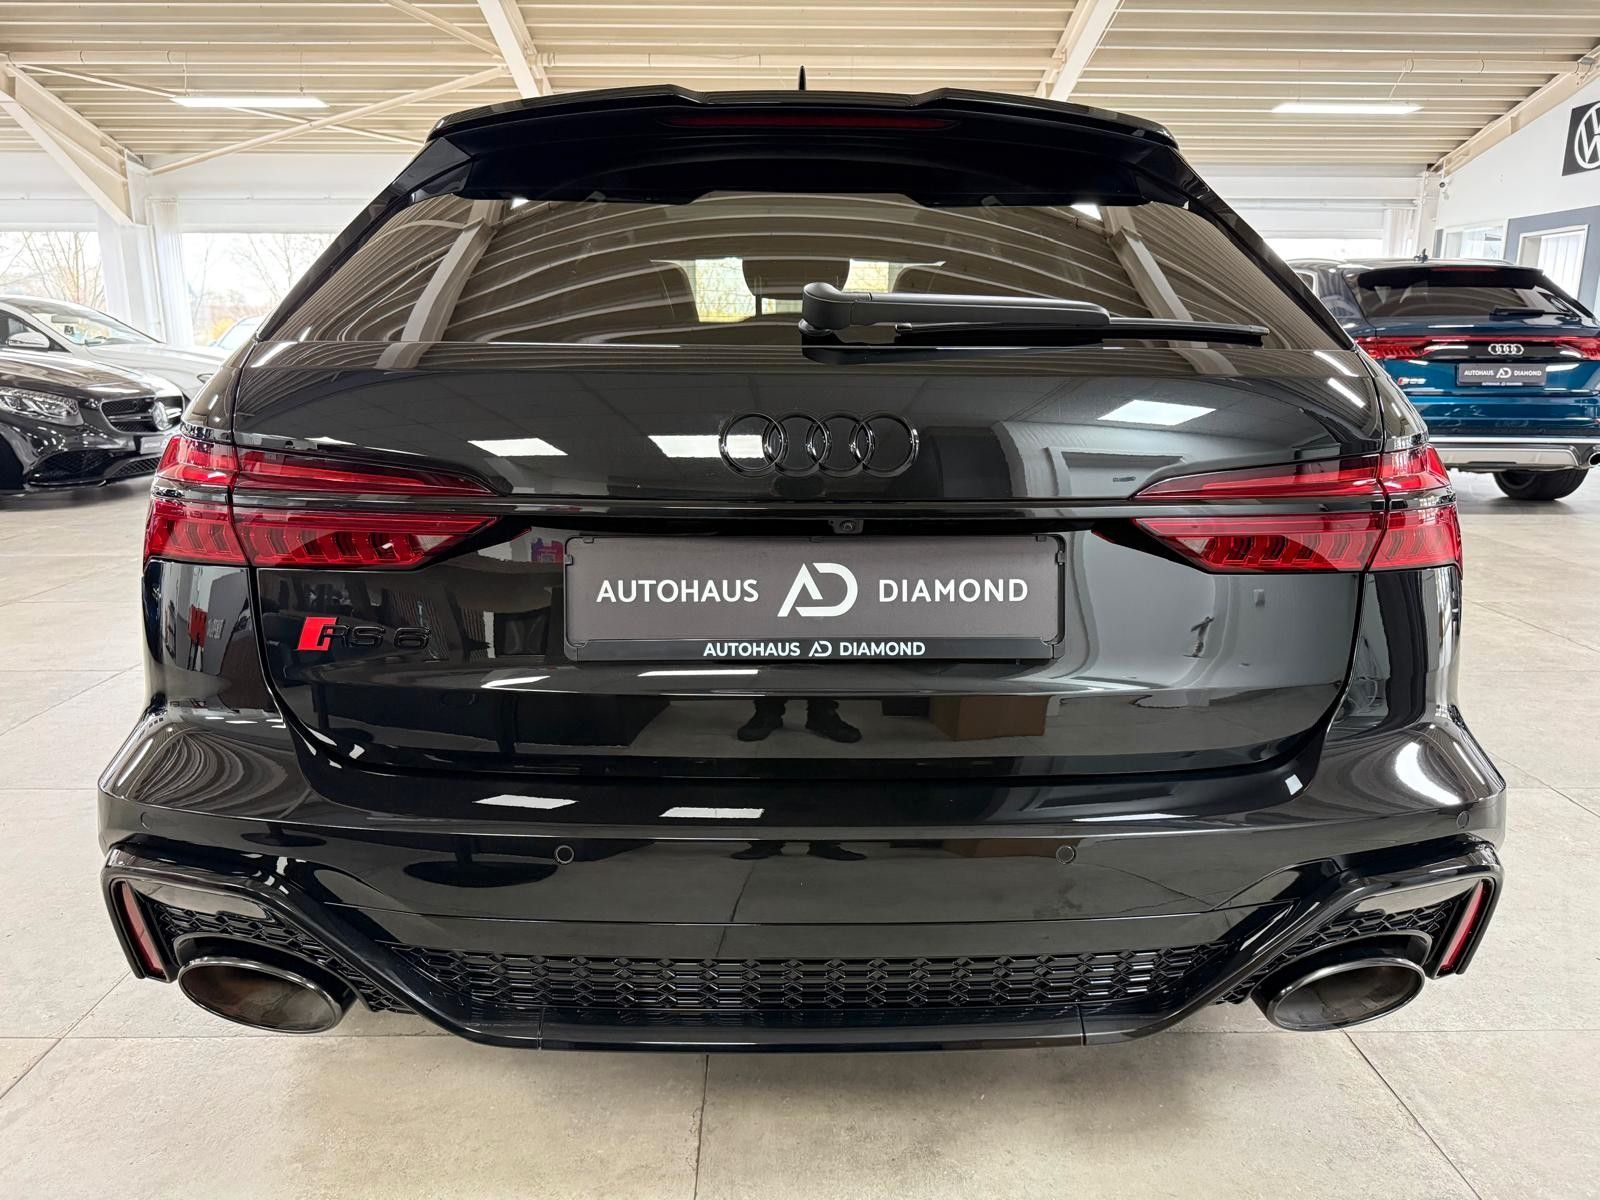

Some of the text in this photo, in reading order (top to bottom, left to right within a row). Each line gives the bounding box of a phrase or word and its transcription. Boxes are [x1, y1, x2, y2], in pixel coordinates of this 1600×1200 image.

[596, 579, 759, 603] AUTOHAUS
[879, 579, 1029, 603] DIAMOND
[703, 641, 801, 657] AUTOHAUS
[839, 641, 926, 656] DIAMOND
